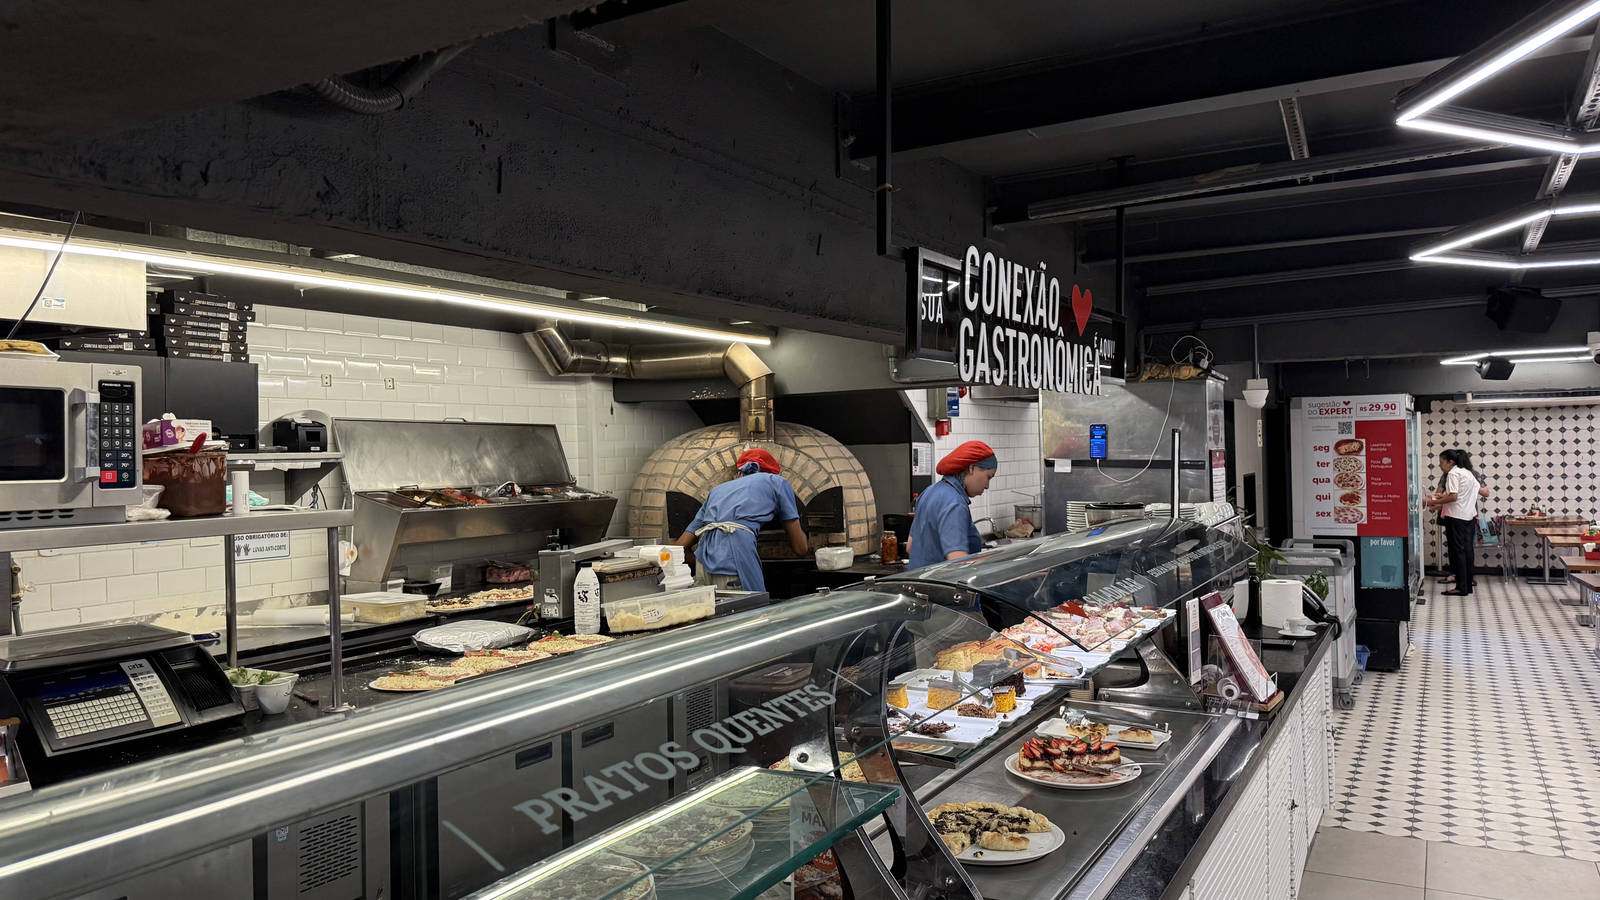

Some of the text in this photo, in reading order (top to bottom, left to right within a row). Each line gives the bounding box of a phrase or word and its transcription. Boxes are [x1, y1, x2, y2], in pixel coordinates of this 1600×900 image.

[964, 245, 1060, 332] CONEXÃO
[921, 295, 943, 324] SUA
[959, 317, 1102, 396] GASTRONÔMICA
[1308, 400, 1340, 409] sugestão
[1369, 403, 1396, 412] 29,90
[1312, 477, 1330, 485] qua
[1316, 493, 1330, 502] qui
[1082, 578, 1145, 608] SALADA BAR
[512, 683, 836, 835] PRATOS QUENTES
